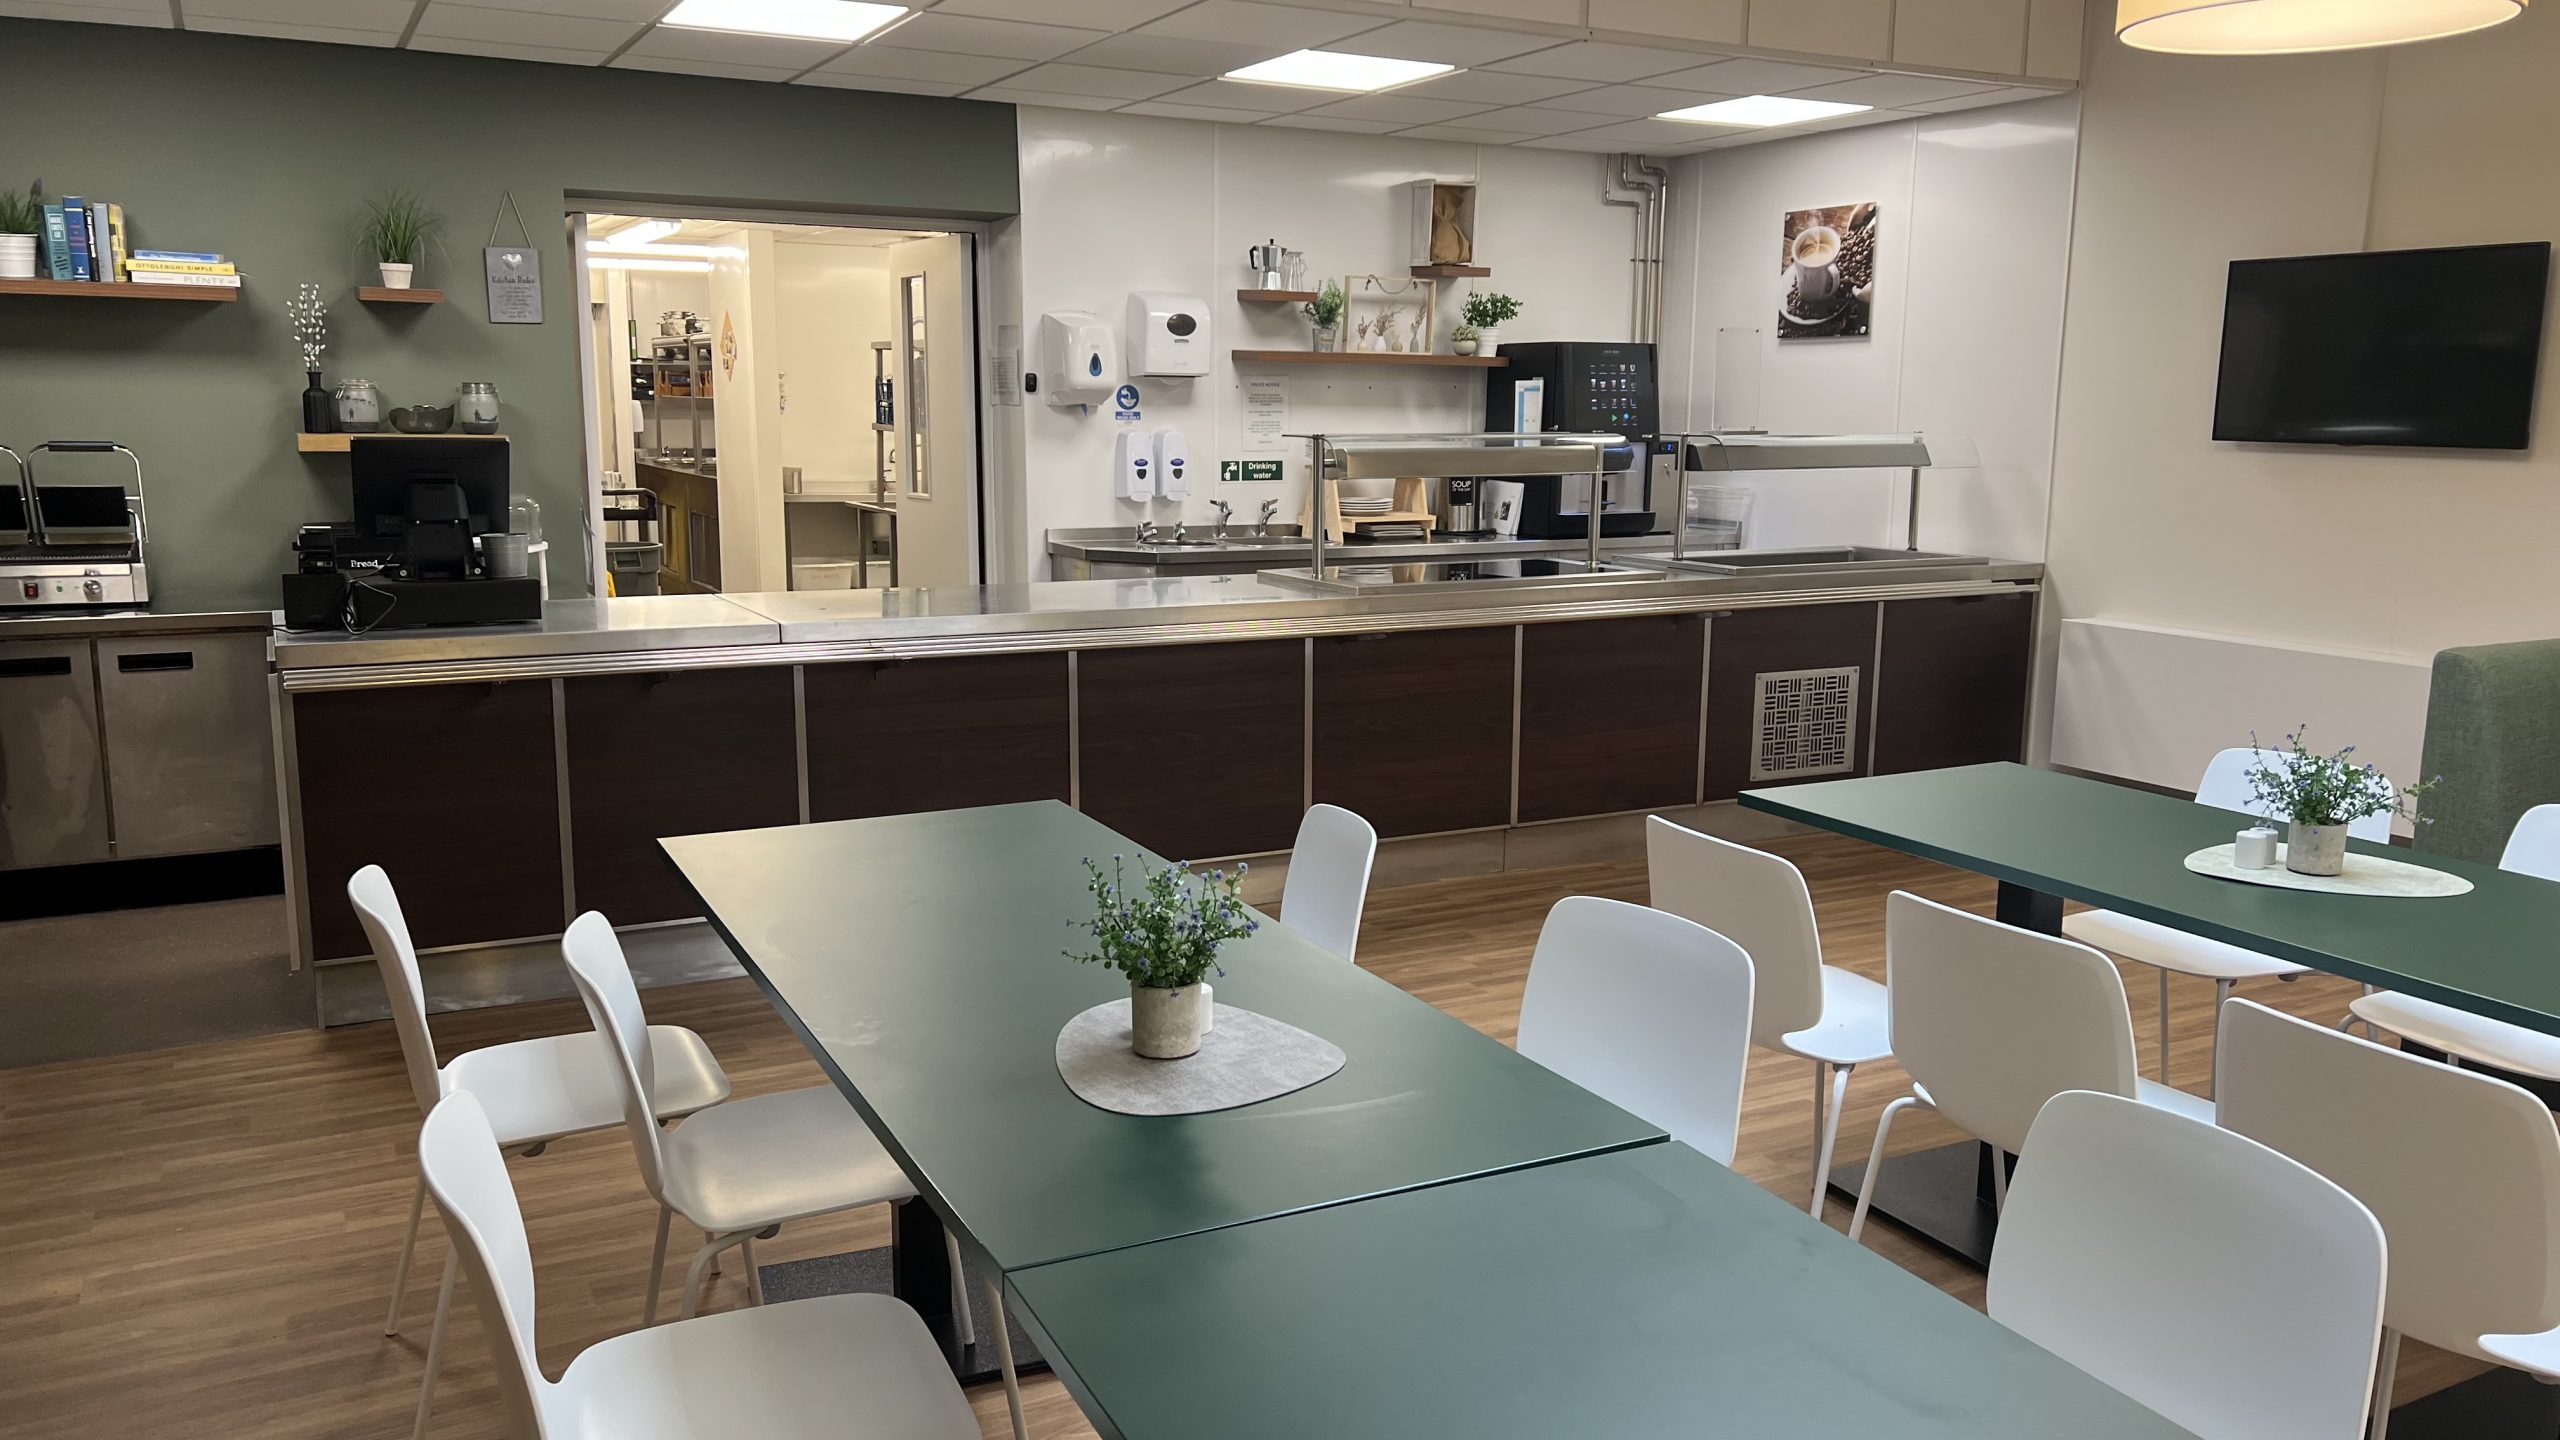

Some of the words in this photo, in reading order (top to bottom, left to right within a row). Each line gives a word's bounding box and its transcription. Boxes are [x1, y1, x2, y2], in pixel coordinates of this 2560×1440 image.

[136, 262, 184, 271] OTTOLENGHI
[183, 276, 225, 285] PLENTY
[1248, 462, 1277, 471] Drinking
[1451, 480, 1472, 488] SOUP
[350, 559, 378, 568] Bread
